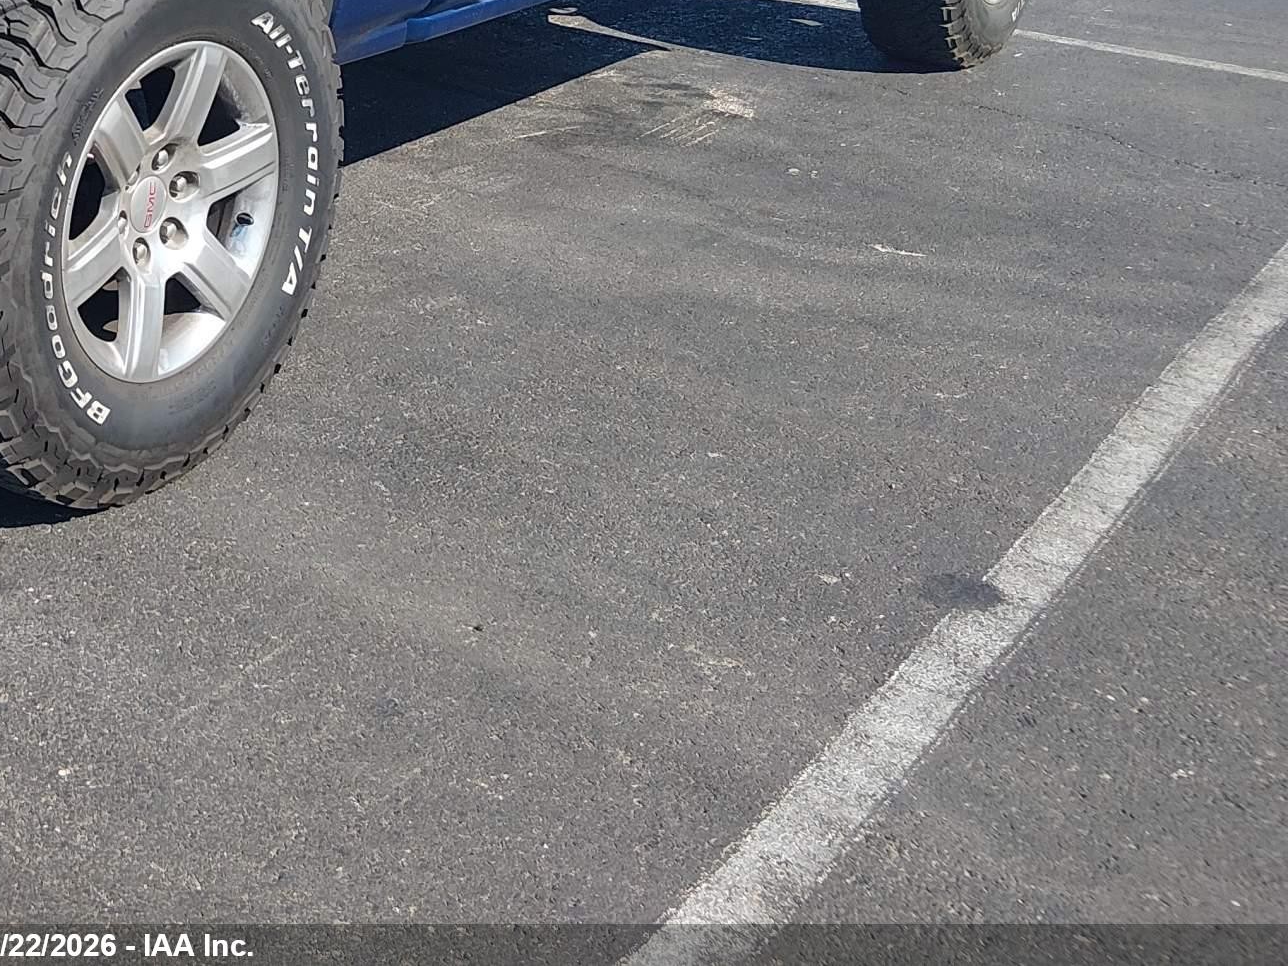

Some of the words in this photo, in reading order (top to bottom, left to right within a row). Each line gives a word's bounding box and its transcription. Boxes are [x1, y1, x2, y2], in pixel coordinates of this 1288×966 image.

[251, 10, 320, 216] All-Terrain
[143, 181, 156, 228] GMC
[281, 226, 313, 296] T/A
[43, 151, 111, 426] BFGoodrich
